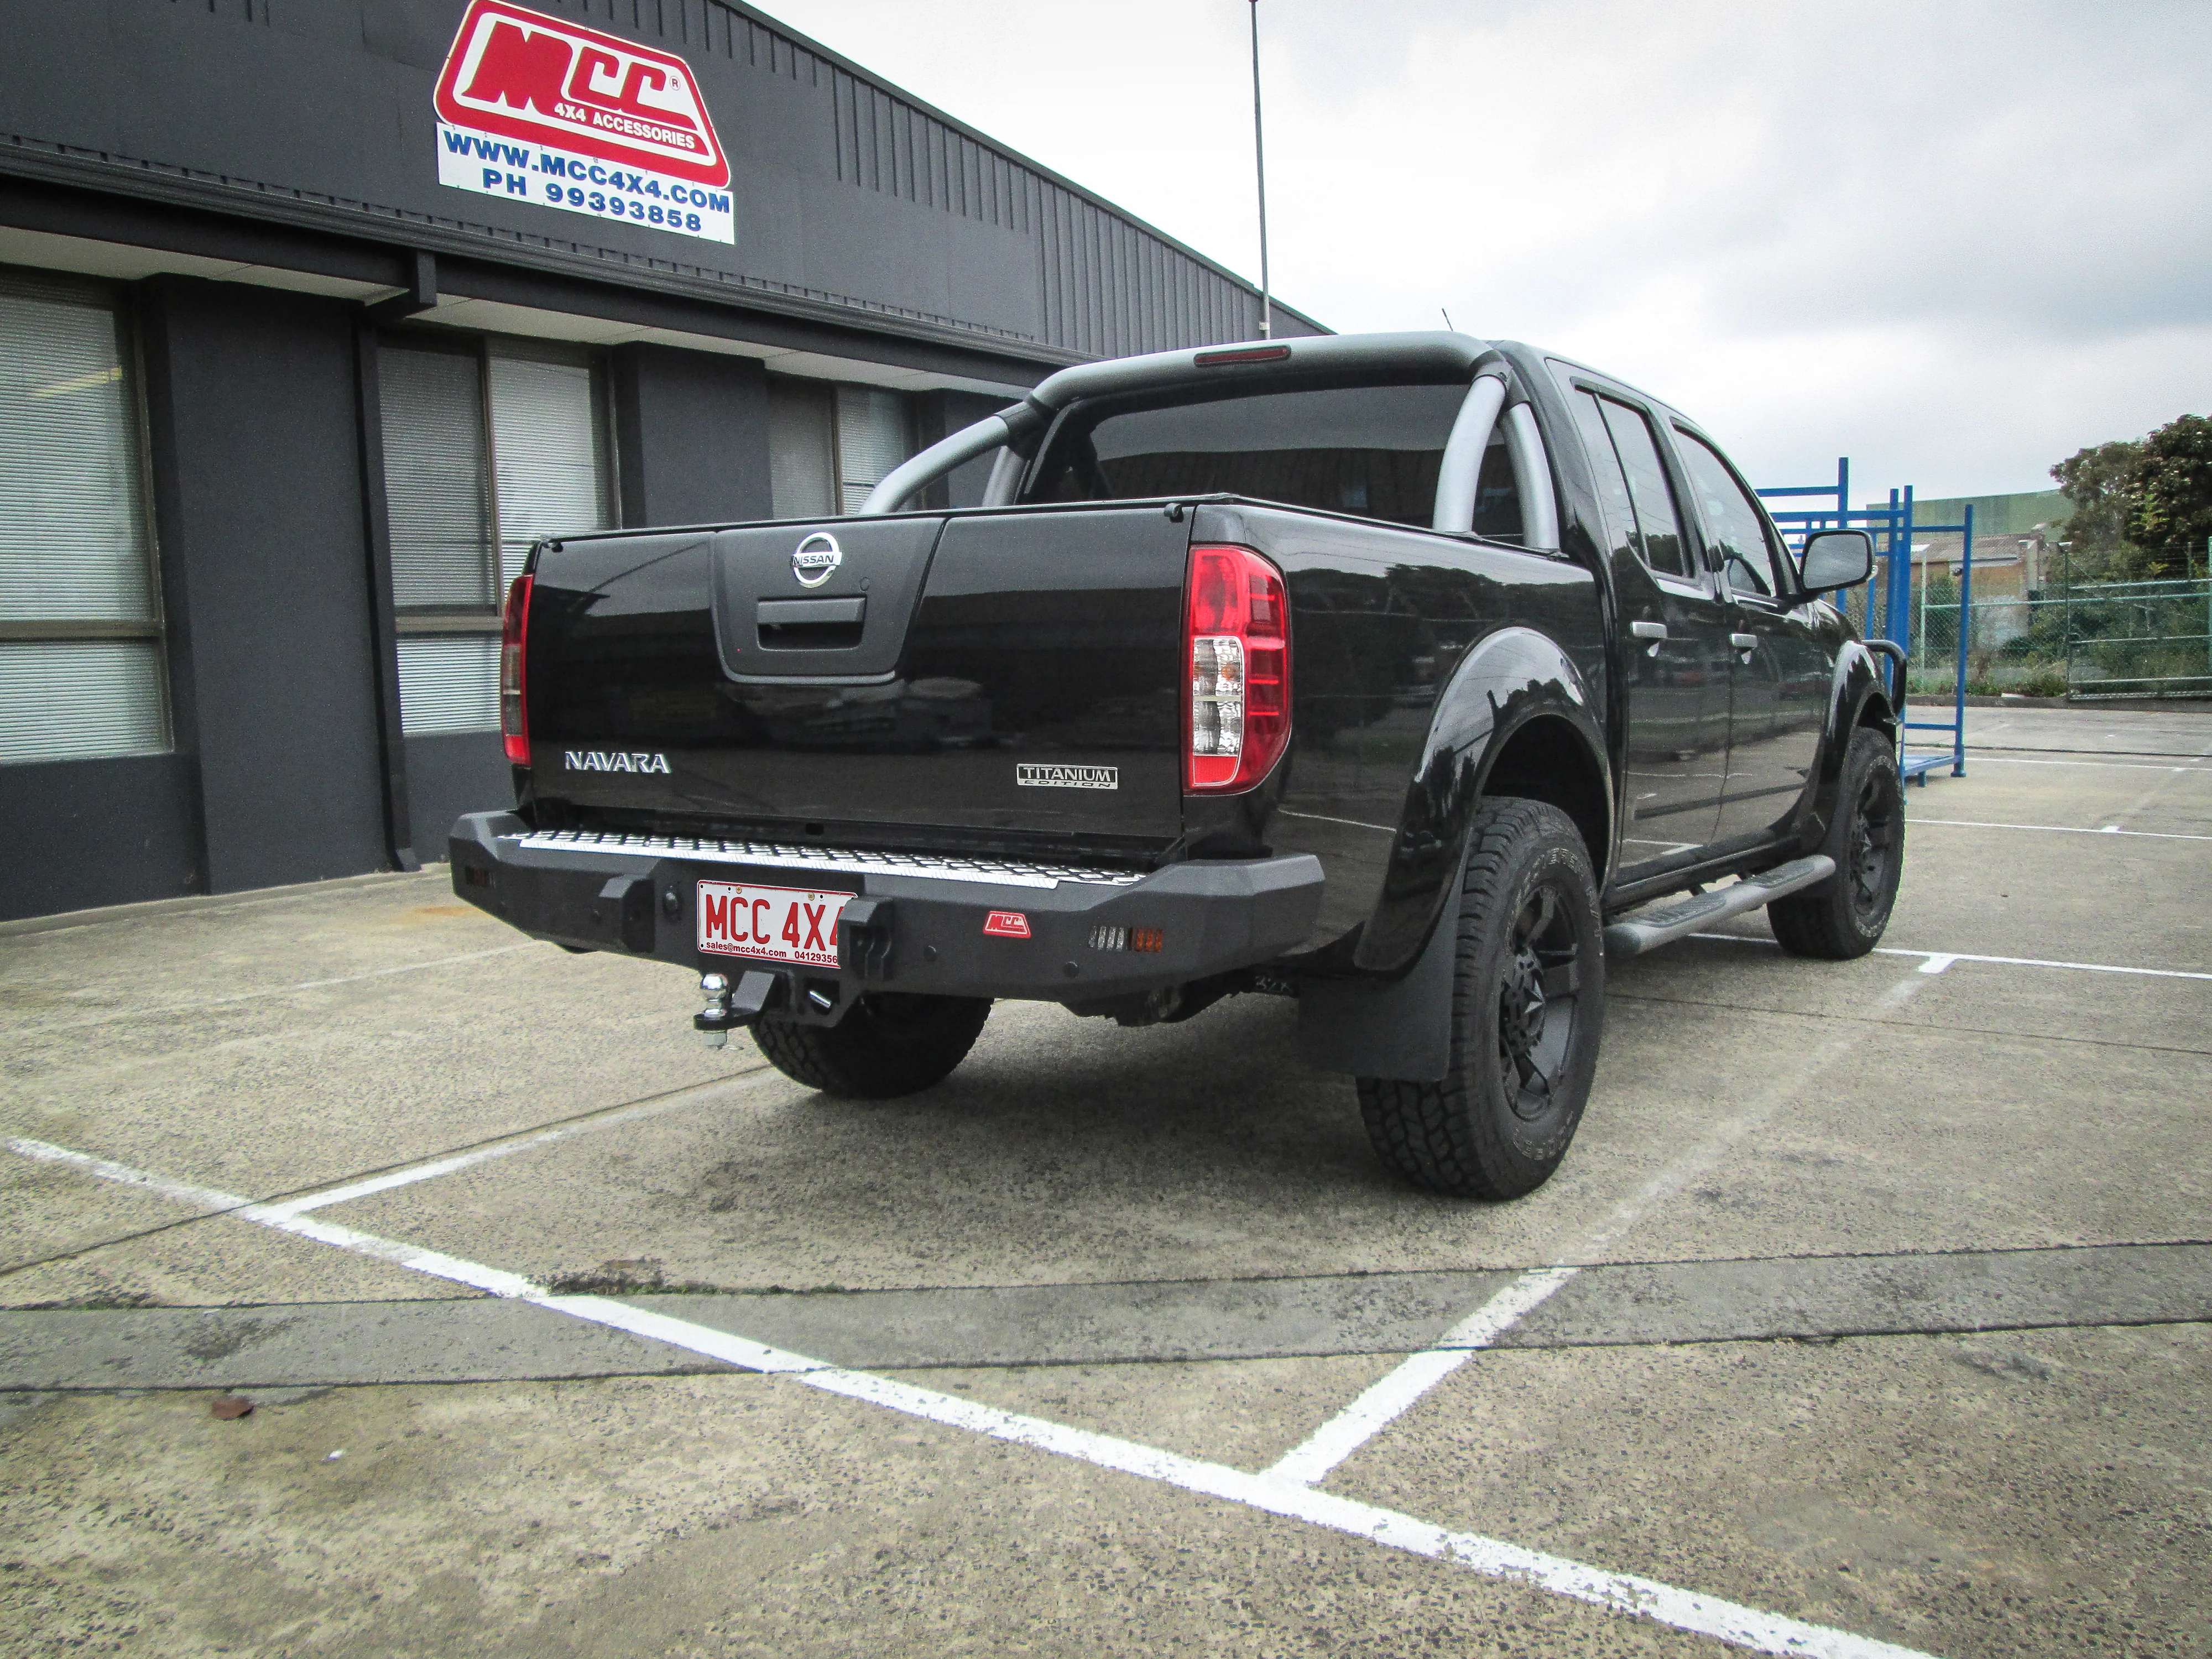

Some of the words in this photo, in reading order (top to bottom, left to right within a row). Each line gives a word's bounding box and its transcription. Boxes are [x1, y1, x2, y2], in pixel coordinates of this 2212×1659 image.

[461, 20, 698, 131] MCC
[554, 103, 586, 122] 4X4
[593, 114, 695, 149] ACCESSORIES
[443, 131, 729, 213] WWW.MCC4X4.COM
[483, 168, 527, 196] PH
[545, 184, 701, 232] 99393858
[794, 555, 834, 564] NISSAN
[565, 751, 672, 774] NAVARA
[1023, 767, 1111, 782] TITANIUM
[706, 894, 770, 945] MCC
[987, 915, 1024, 930] MCC
[706, 941, 787, 958] sales@mcc4x4.com
